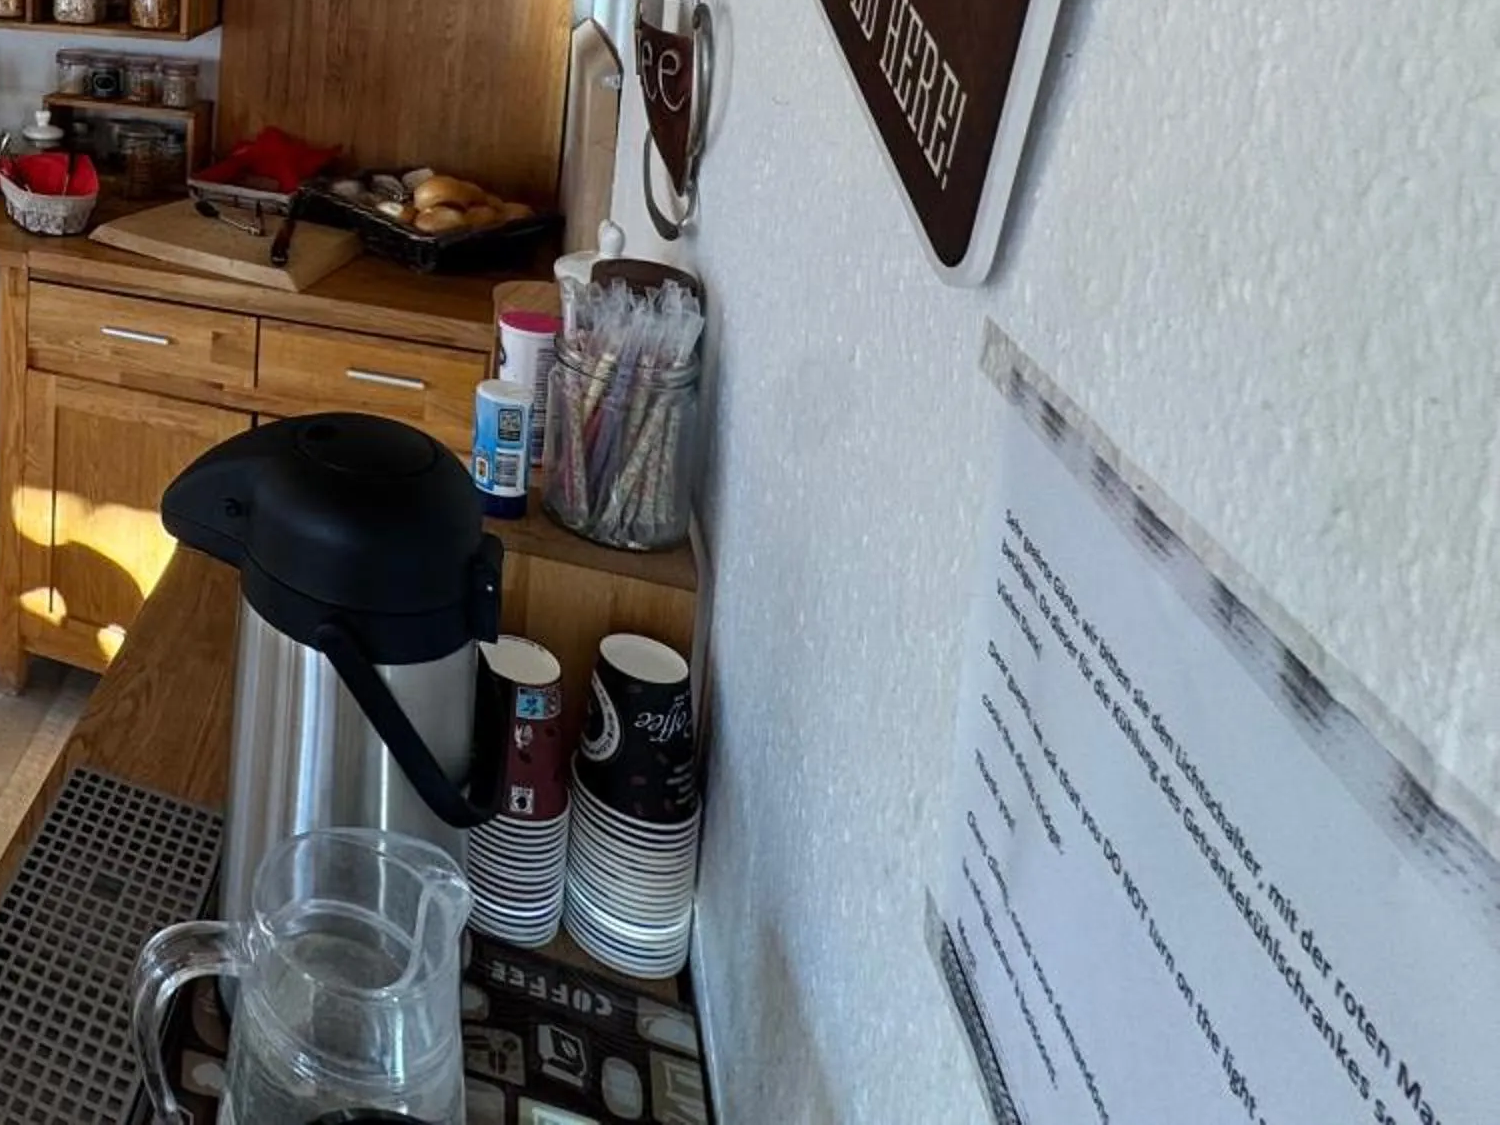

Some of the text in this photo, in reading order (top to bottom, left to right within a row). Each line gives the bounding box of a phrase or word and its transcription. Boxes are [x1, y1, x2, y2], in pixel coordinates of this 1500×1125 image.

[489, 959, 614, 1017] COFFEE
[1081, 804, 1103, 845] you
[1102, 836, 1123, 876] DO
[1122, 870, 1149, 922] NOT
[1148, 917, 1175, 974] turn
[1175, 970, 1195, 1008] on
[1196, 1002, 1222, 1055] the
[1221, 1045, 1258, 1121] light
[1093, 678, 1112, 710] die
[1111, 700, 1160, 784] Kühlung
[1159, 774, 1182, 815] des
[1182, 806, 1371, 1101] Getränkekühlschrankes
[1151, 713, 1175, 754] den
[1267, 883, 1299, 934] mit
[1299, 929, 1333, 980] der
[1334, 978, 1392, 1069] roten
